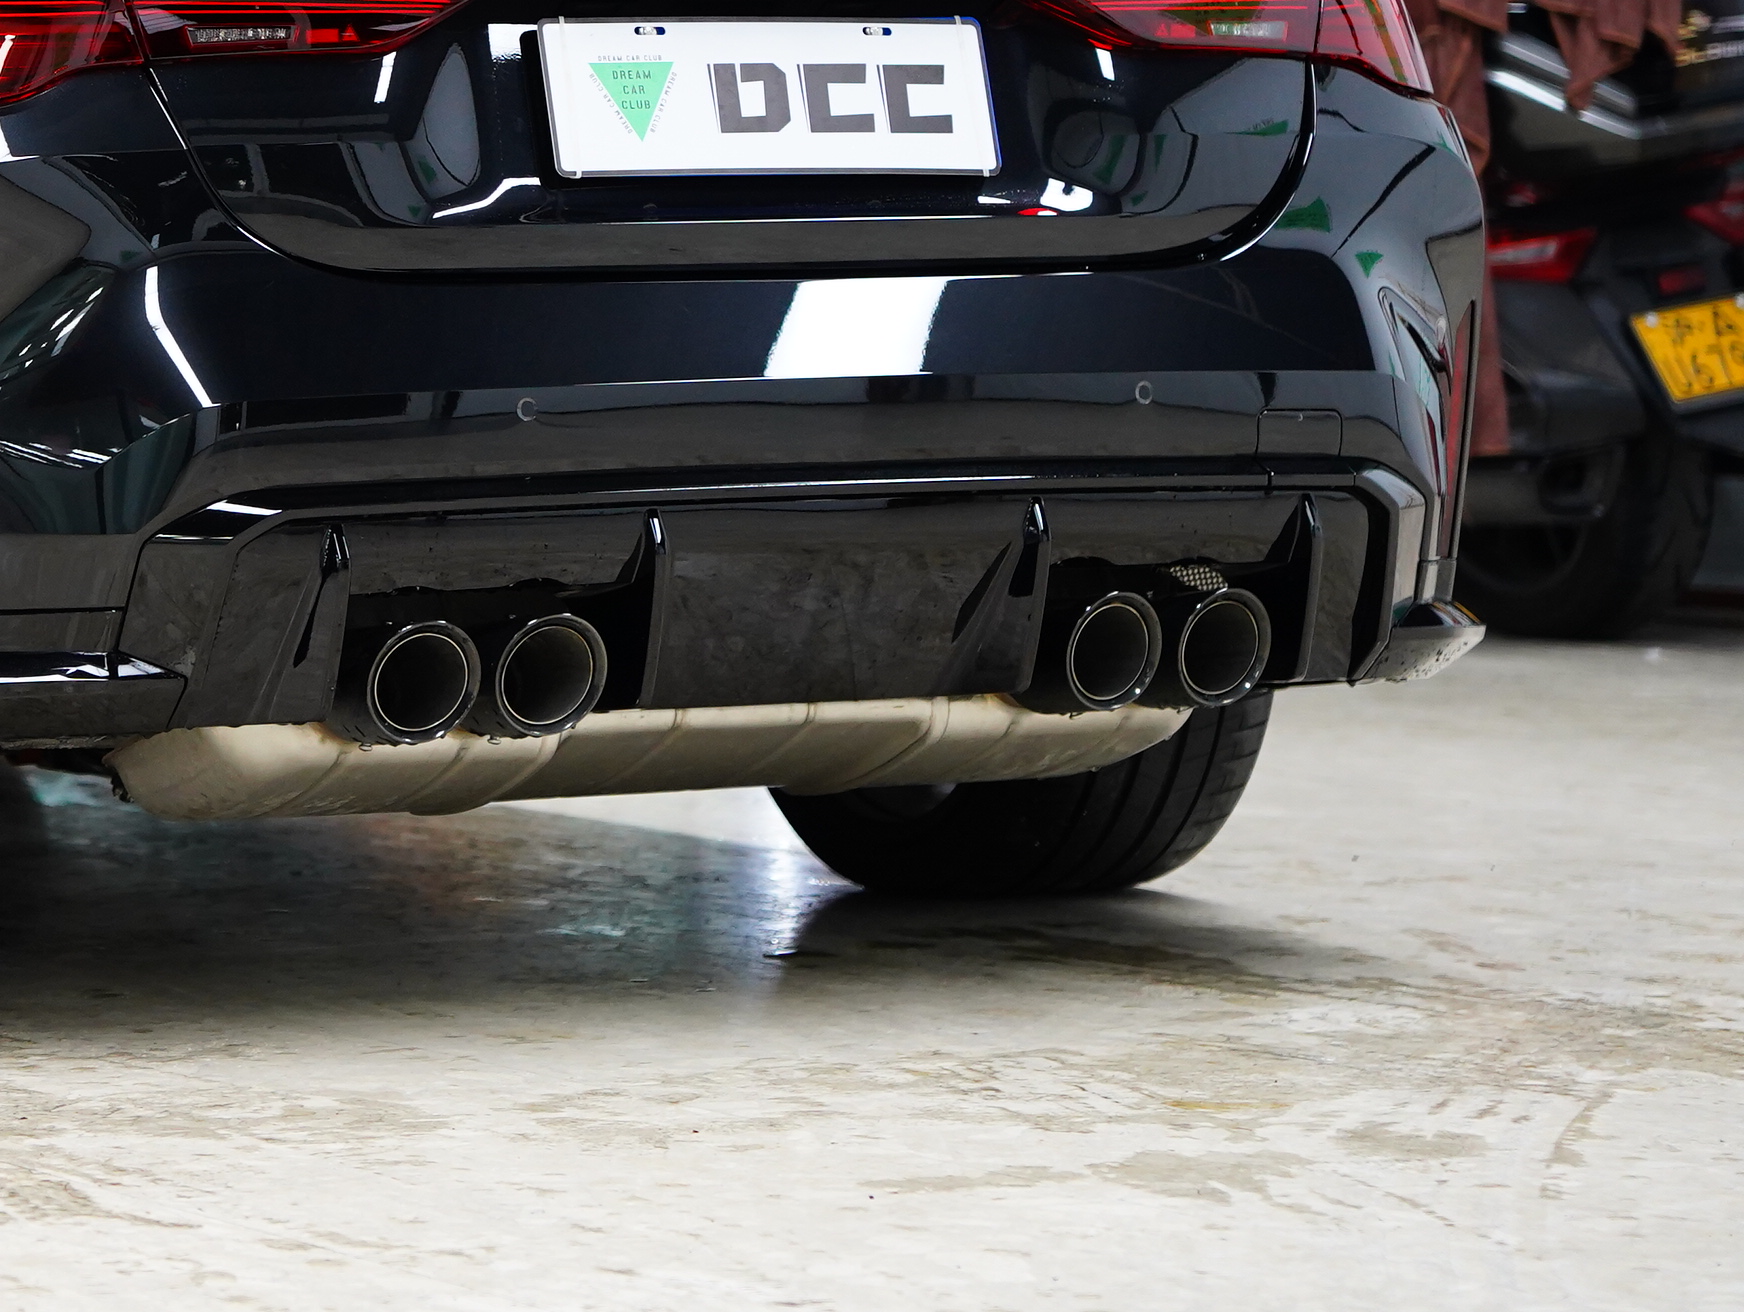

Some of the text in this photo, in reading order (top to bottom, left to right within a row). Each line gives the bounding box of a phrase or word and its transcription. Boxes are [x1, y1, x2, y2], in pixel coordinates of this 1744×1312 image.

[612, 70, 652, 80] DREAM
[622, 85, 646, 95] CAR
[707, 63, 954, 134] DCC
[621, 99, 651, 110] CLUB
